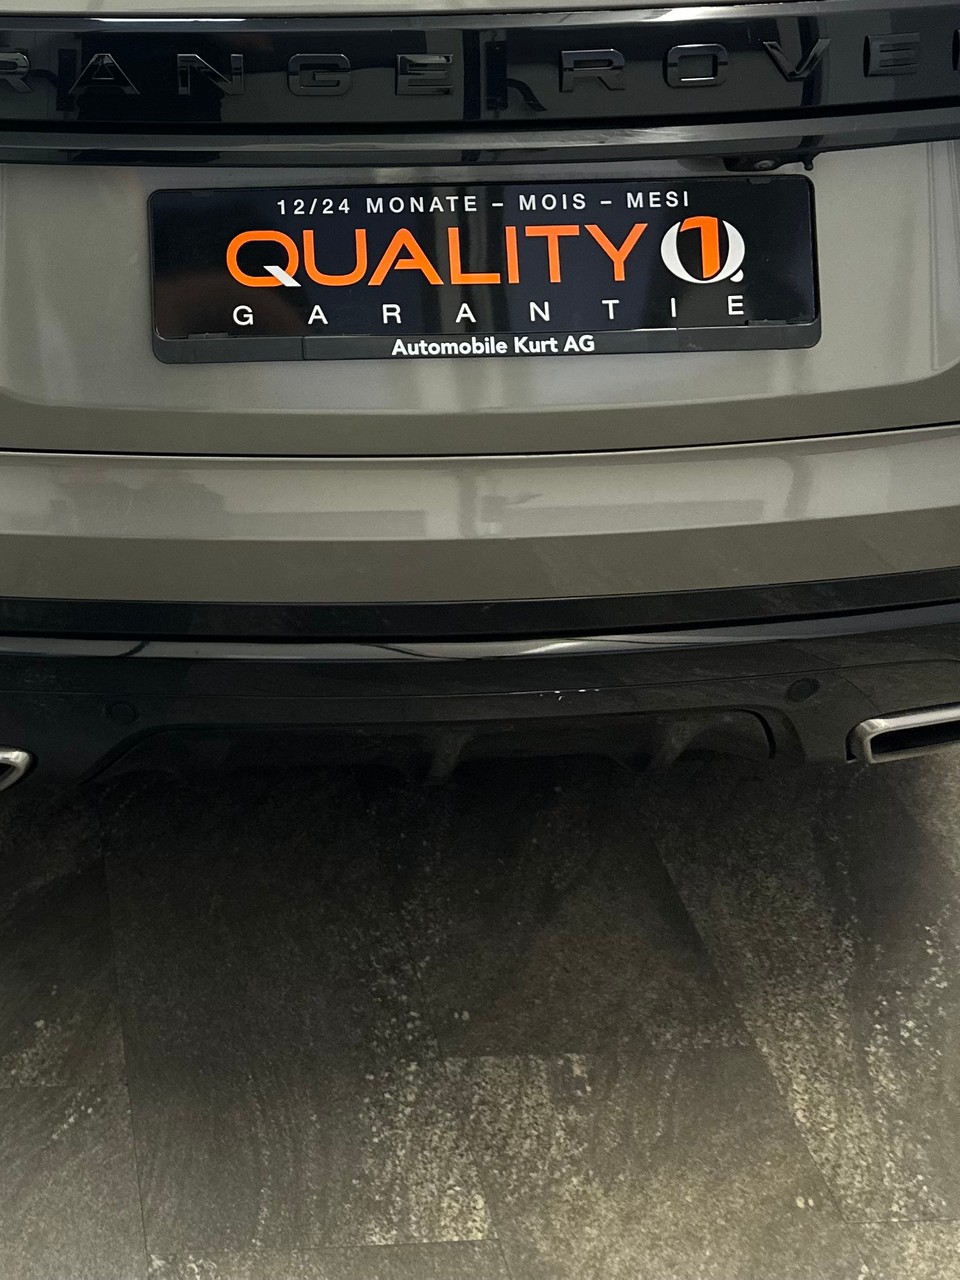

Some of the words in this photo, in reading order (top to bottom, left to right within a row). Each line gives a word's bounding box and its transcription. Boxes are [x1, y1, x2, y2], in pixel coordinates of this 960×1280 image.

[559, 28, 960, 93] ROVE
[277, 198, 350, 215] 12/24
[366, 195, 477, 213] MONATE
[519, 193, 586, 211] MOIS
[627, 190, 689, 208] MESI
[226, 223, 648, 288] QUALITY
[232, 294, 744, 326] GARANTIE
[391, 336, 508, 357] Automobile
[514, 336, 558, 354] Kurt
[563, 334, 596, 352] AG
